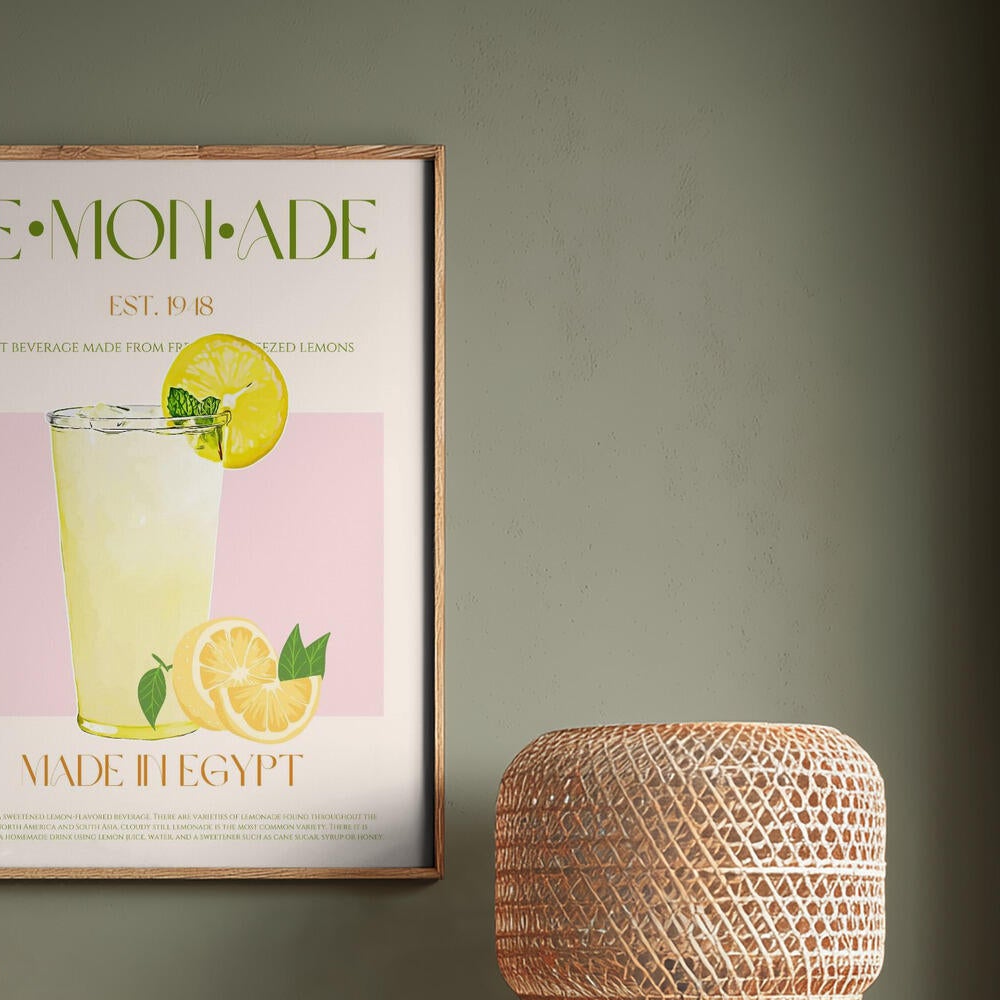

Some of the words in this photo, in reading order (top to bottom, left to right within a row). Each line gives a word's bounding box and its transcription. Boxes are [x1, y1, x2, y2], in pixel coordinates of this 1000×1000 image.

[109, 295, 159, 317] EST.
[11, 341, 78, 354] BEVERAGE
[82, 341, 122, 354] MADE
[125, 341, 165, 354] FROM
[299, 341, 355, 354] LEMONS
[20, 753, 125, 788] MADE
[136, 753, 167, 788] IN
[179, 753, 304, 788] EGYPT
